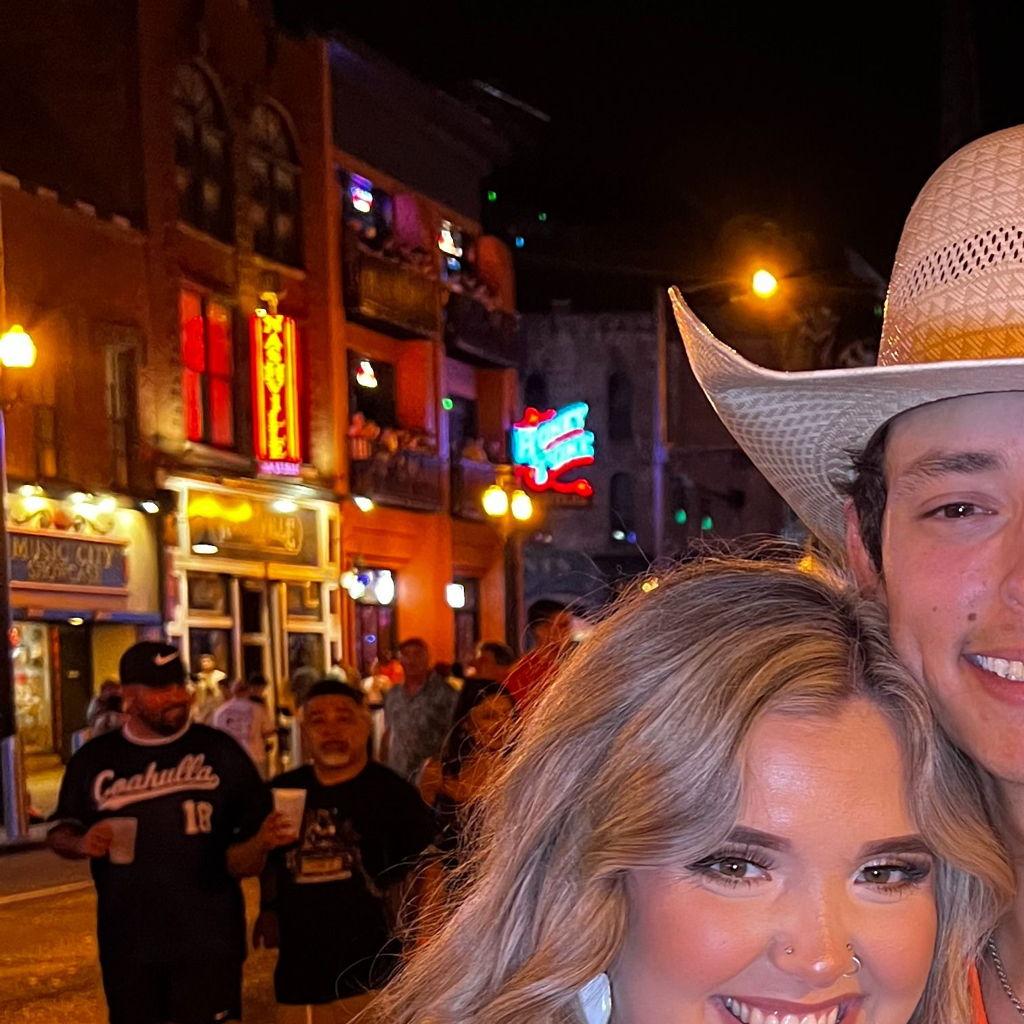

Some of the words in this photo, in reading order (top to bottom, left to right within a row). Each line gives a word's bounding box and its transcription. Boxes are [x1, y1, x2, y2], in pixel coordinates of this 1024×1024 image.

[262, 314, 287, 460] NASHVILLE
[12, 537, 71, 564] MUSIC
[75, 542, 114, 570] CITY
